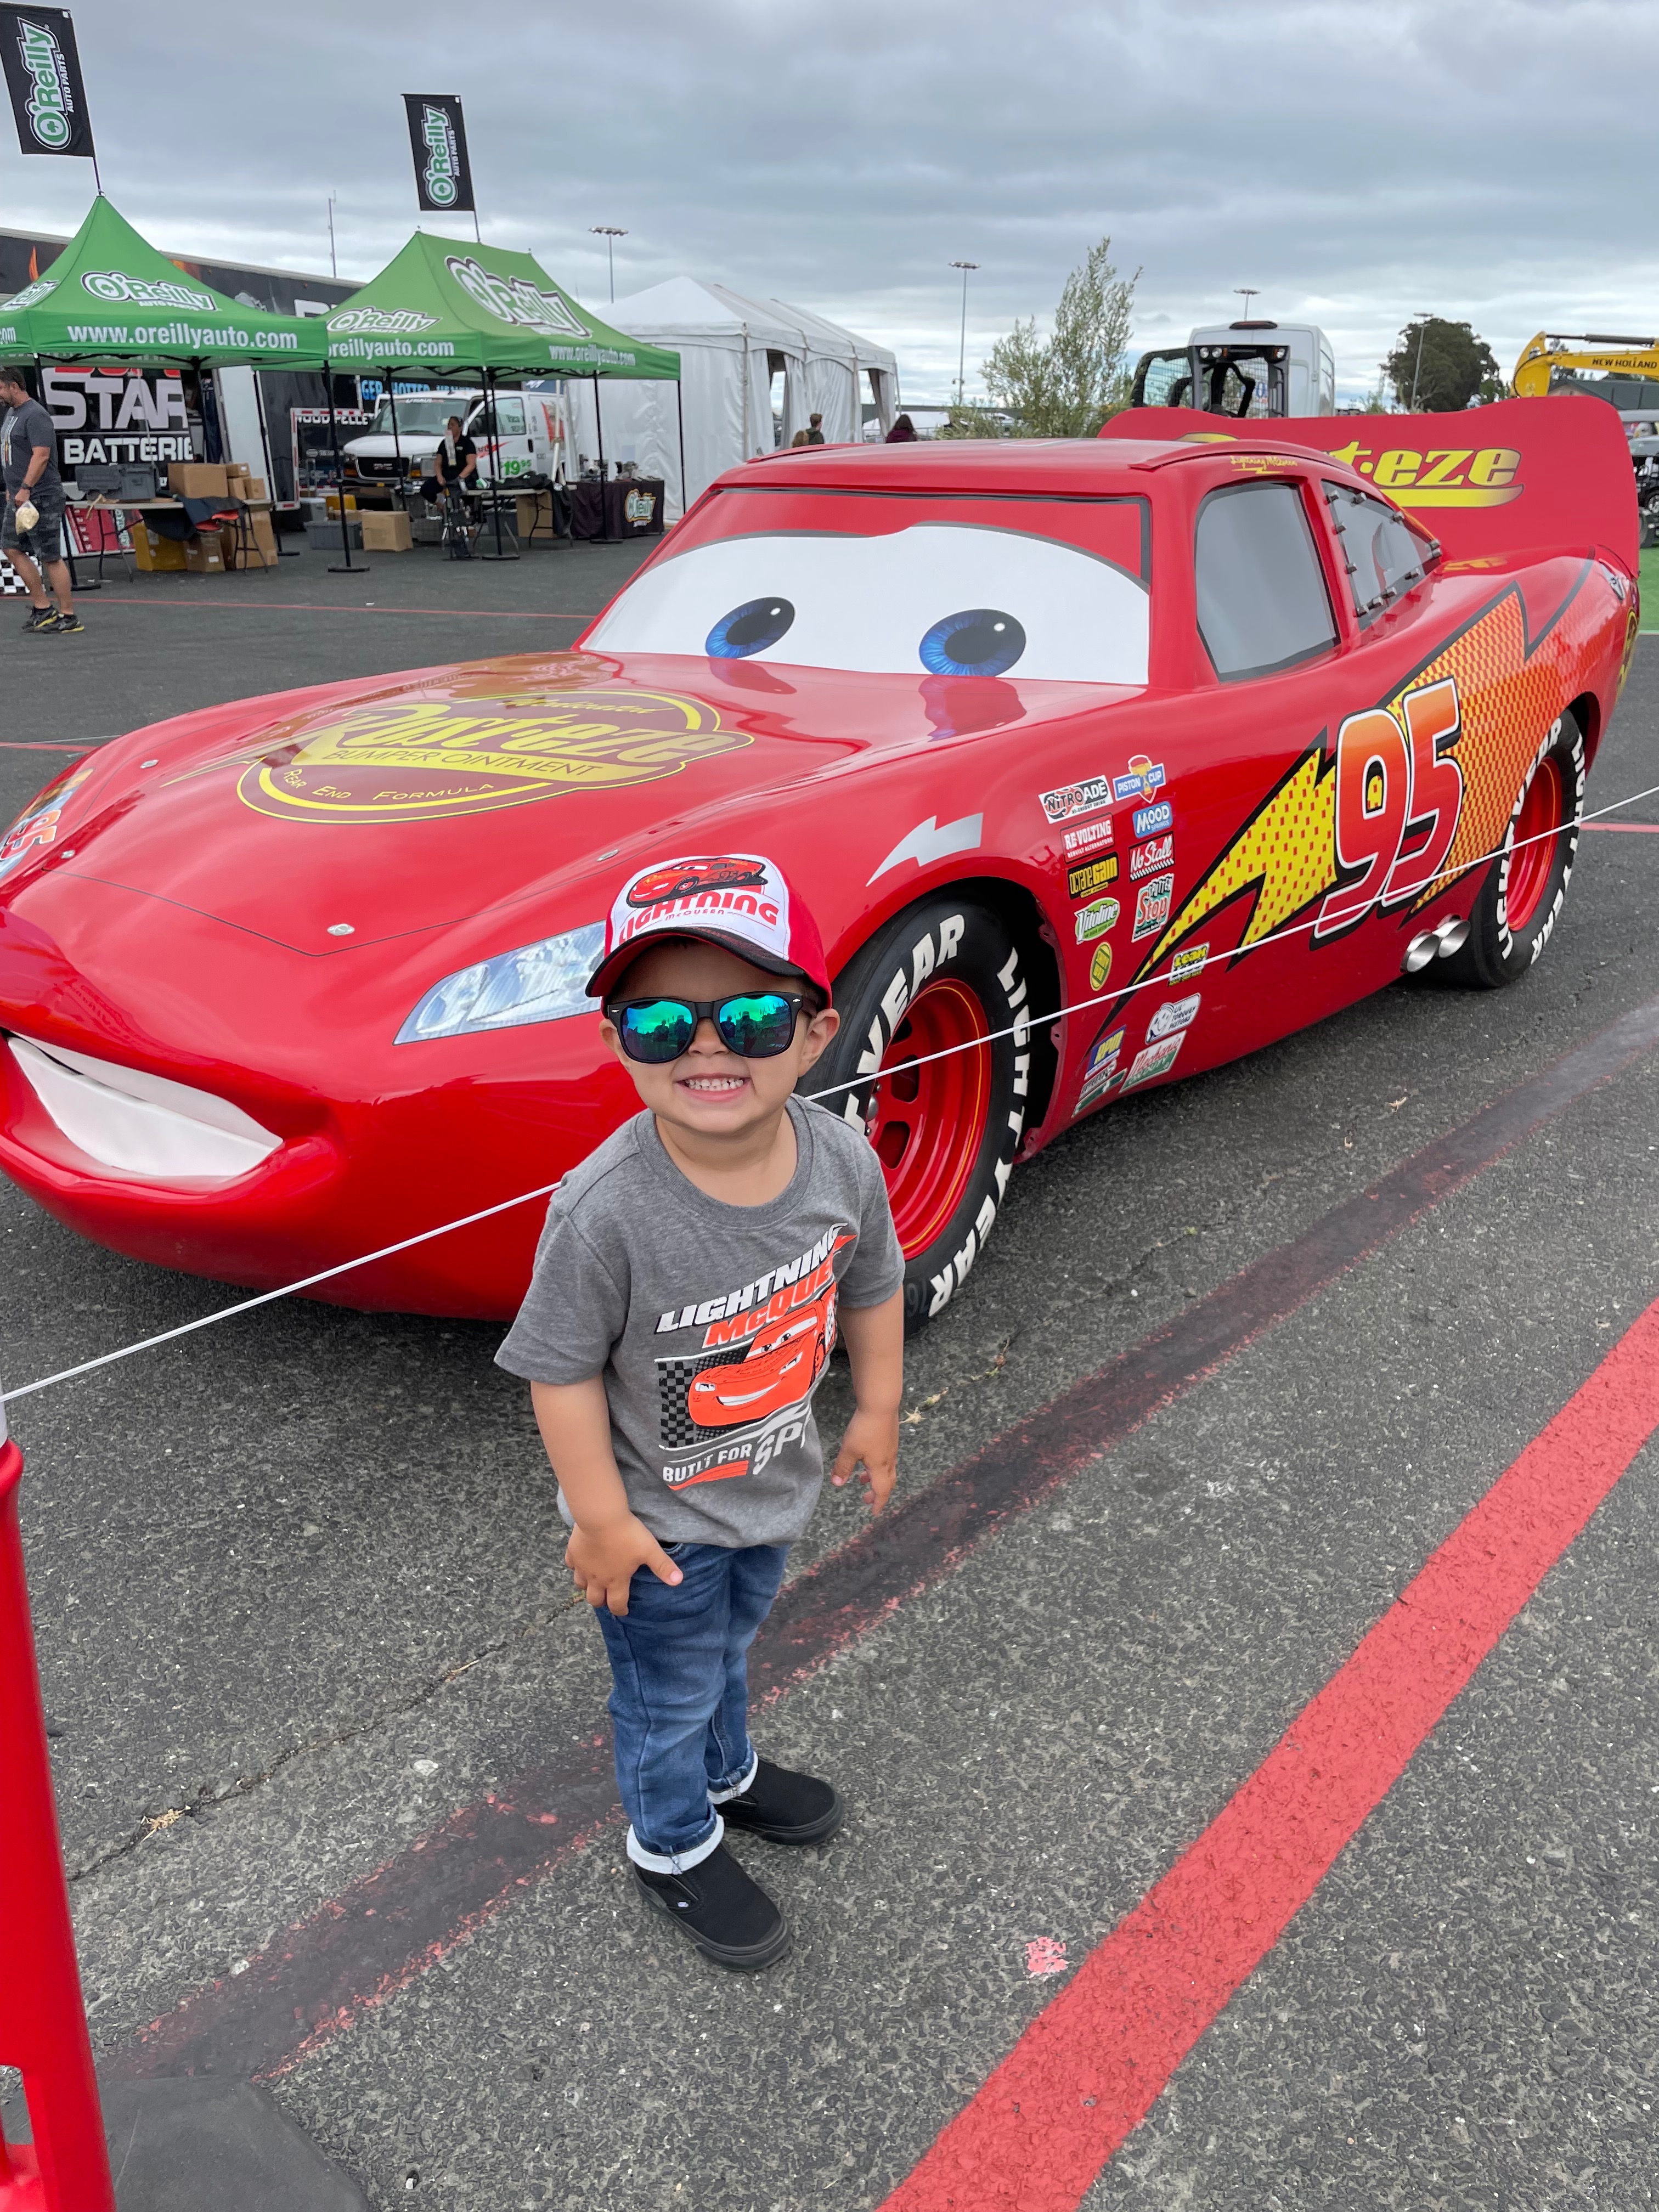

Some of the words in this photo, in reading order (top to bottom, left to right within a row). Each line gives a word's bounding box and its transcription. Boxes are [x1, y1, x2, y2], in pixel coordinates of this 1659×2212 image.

[23, 22, 70, 146] O'Reilly
[57, 53, 70, 84] PARTS
[65, 86, 75, 113] AUTO
[425, 106, 456, 205] O'Reilly
[83, 273, 217, 311] O'Reilly
[328, 306, 441, 332] O'Reilly
[67, 323, 298, 350] www.oreillyauto.com
[1592, 357, 1612, 366] NEW
[1615, 357, 1658, 369] HOLLAND
[323, 749, 443, 762] BUMPER
[441, 751, 604, 776] OINTMENT
[283, 768, 307, 789] REAR
[312, 785, 352, 799] END
[372, 783, 495, 801] FORMULA
[1117, 777, 1141, 794] PISTON
[1148, 770, 1162, 783] CUP
[1136, 804, 1170, 834] MOOD
[1313, 676, 1465, 940] 95
[1130, 847, 1145, 873] No
[618, 890, 780, 946] LIGHTNING
[1136, 890, 1169, 927] Stop
[1130, 1036, 1181, 1077] Mechanic
[653, 1222, 848, 1335] LIGHTNING
[663, 1453, 714, 1482] BUILT
[718, 1443, 752, 1465] FOR
